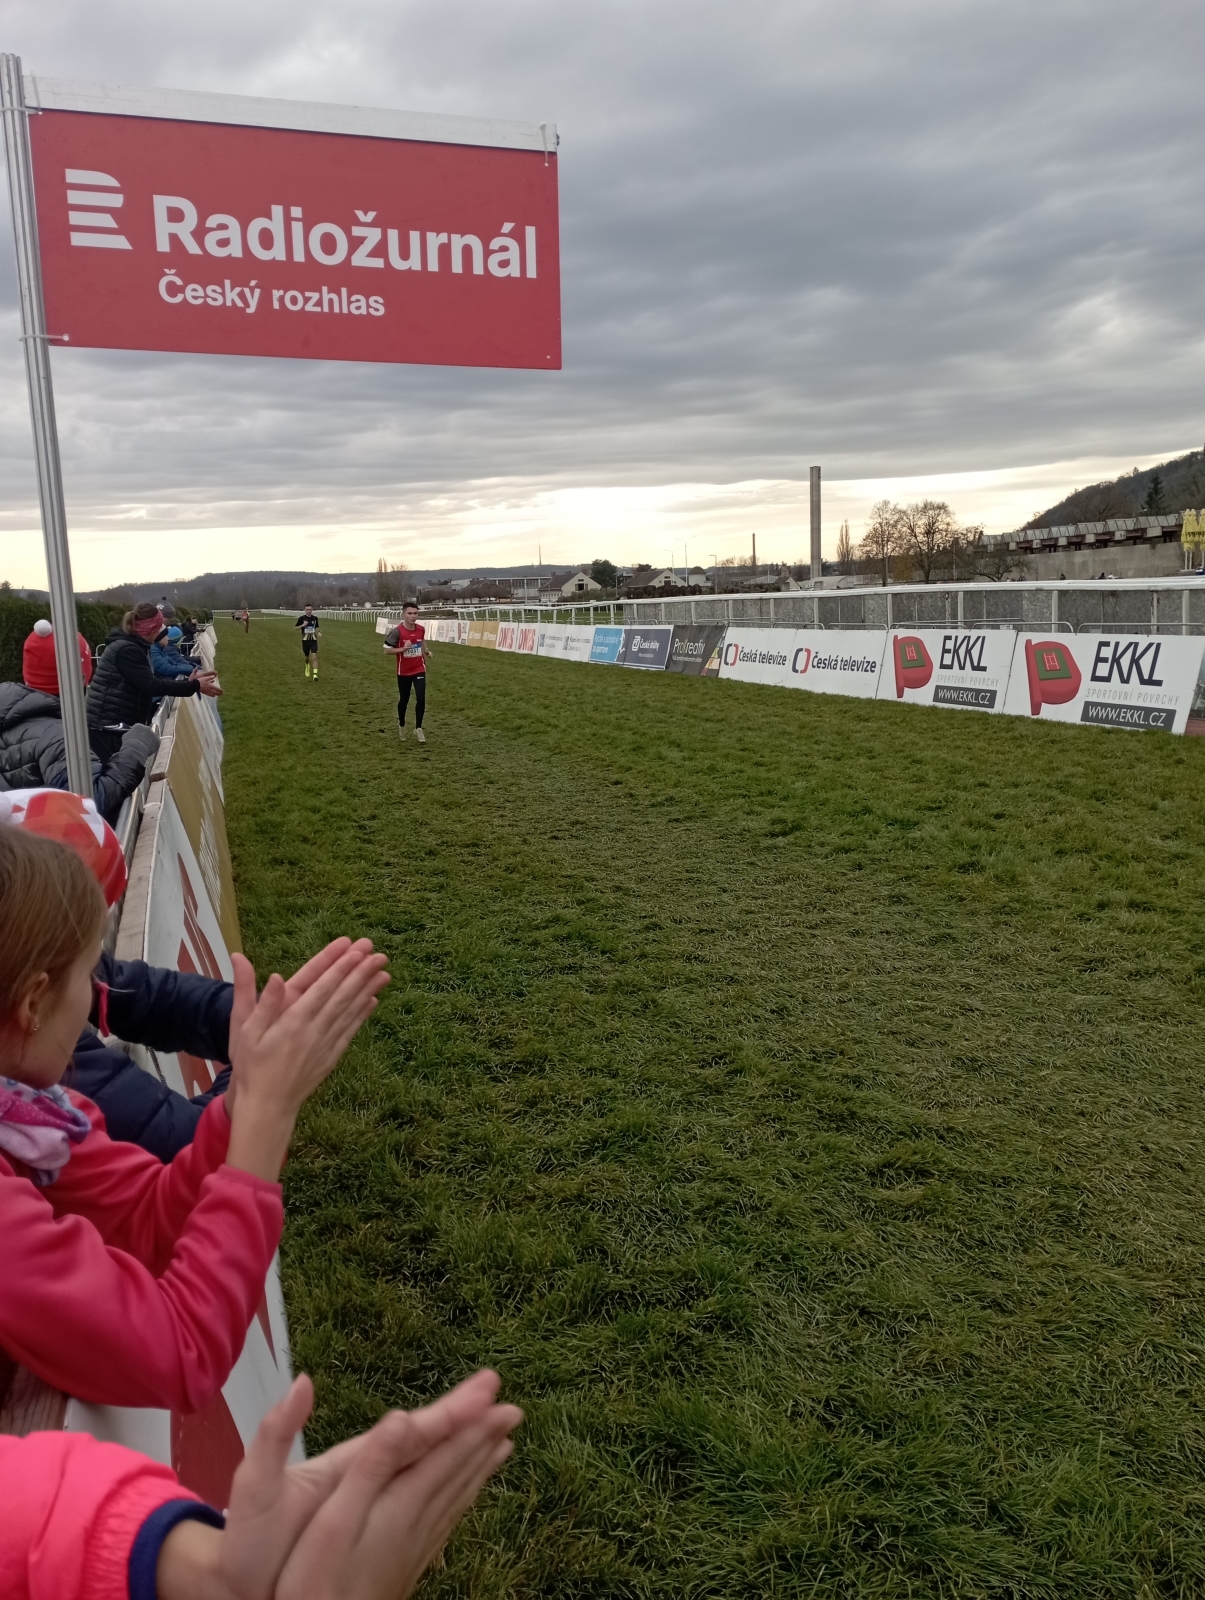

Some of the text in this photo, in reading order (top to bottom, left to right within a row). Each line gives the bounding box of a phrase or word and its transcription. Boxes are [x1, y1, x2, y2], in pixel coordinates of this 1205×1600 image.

[152, 194, 538, 279] Radiožurnál
[158, 268, 386, 317] Český rozhlas
[739, 646, 787, 666] Česká televize
[811, 651, 877, 674] Česká televize
[939, 635, 988, 672] EKKL
[1090, 640, 1164, 687] EKKL
[936, 673, 1000, 688] SPORTOVNÍ POVRCHY
[938, 688, 991, 705] WWW.EKKL.CZ
[1085, 687, 1180, 706] SPORTOVNÍ POVRCHY
[1088, 705, 1167, 727] WWW.EKKL.CZ
